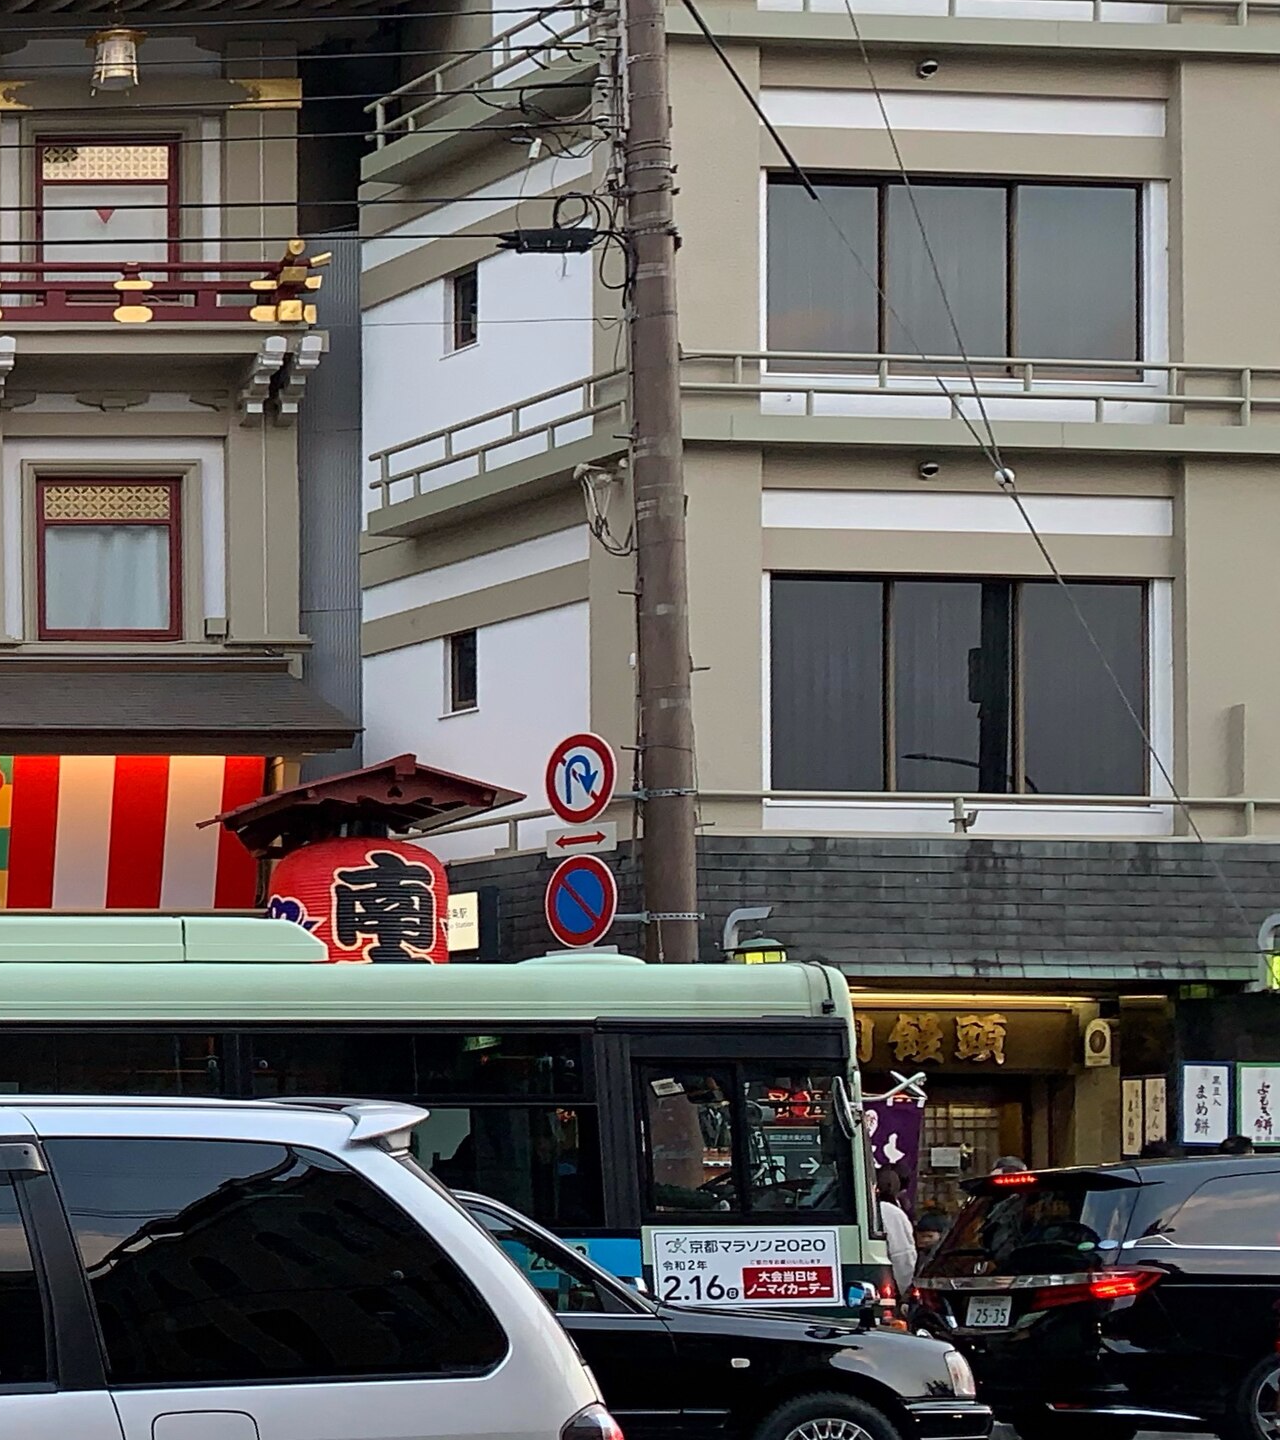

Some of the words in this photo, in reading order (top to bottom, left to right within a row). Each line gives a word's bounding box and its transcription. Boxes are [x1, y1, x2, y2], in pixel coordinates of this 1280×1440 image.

[330, 850, 436, 964] 南
[856, 1013, 1007, 1064] 饅頭
[1194, 1084, 1210, 1137] まめ餅
[689, 1239, 826, 1254] 京都マラソン2020
[662, 1260, 708, 1271] 令和2年
[758, 1271, 818, 1283] 大会当日は
[746, 1283, 831, 1296] ノーマイカーデー
[975, 1308, 1007, 1324] 25-35
